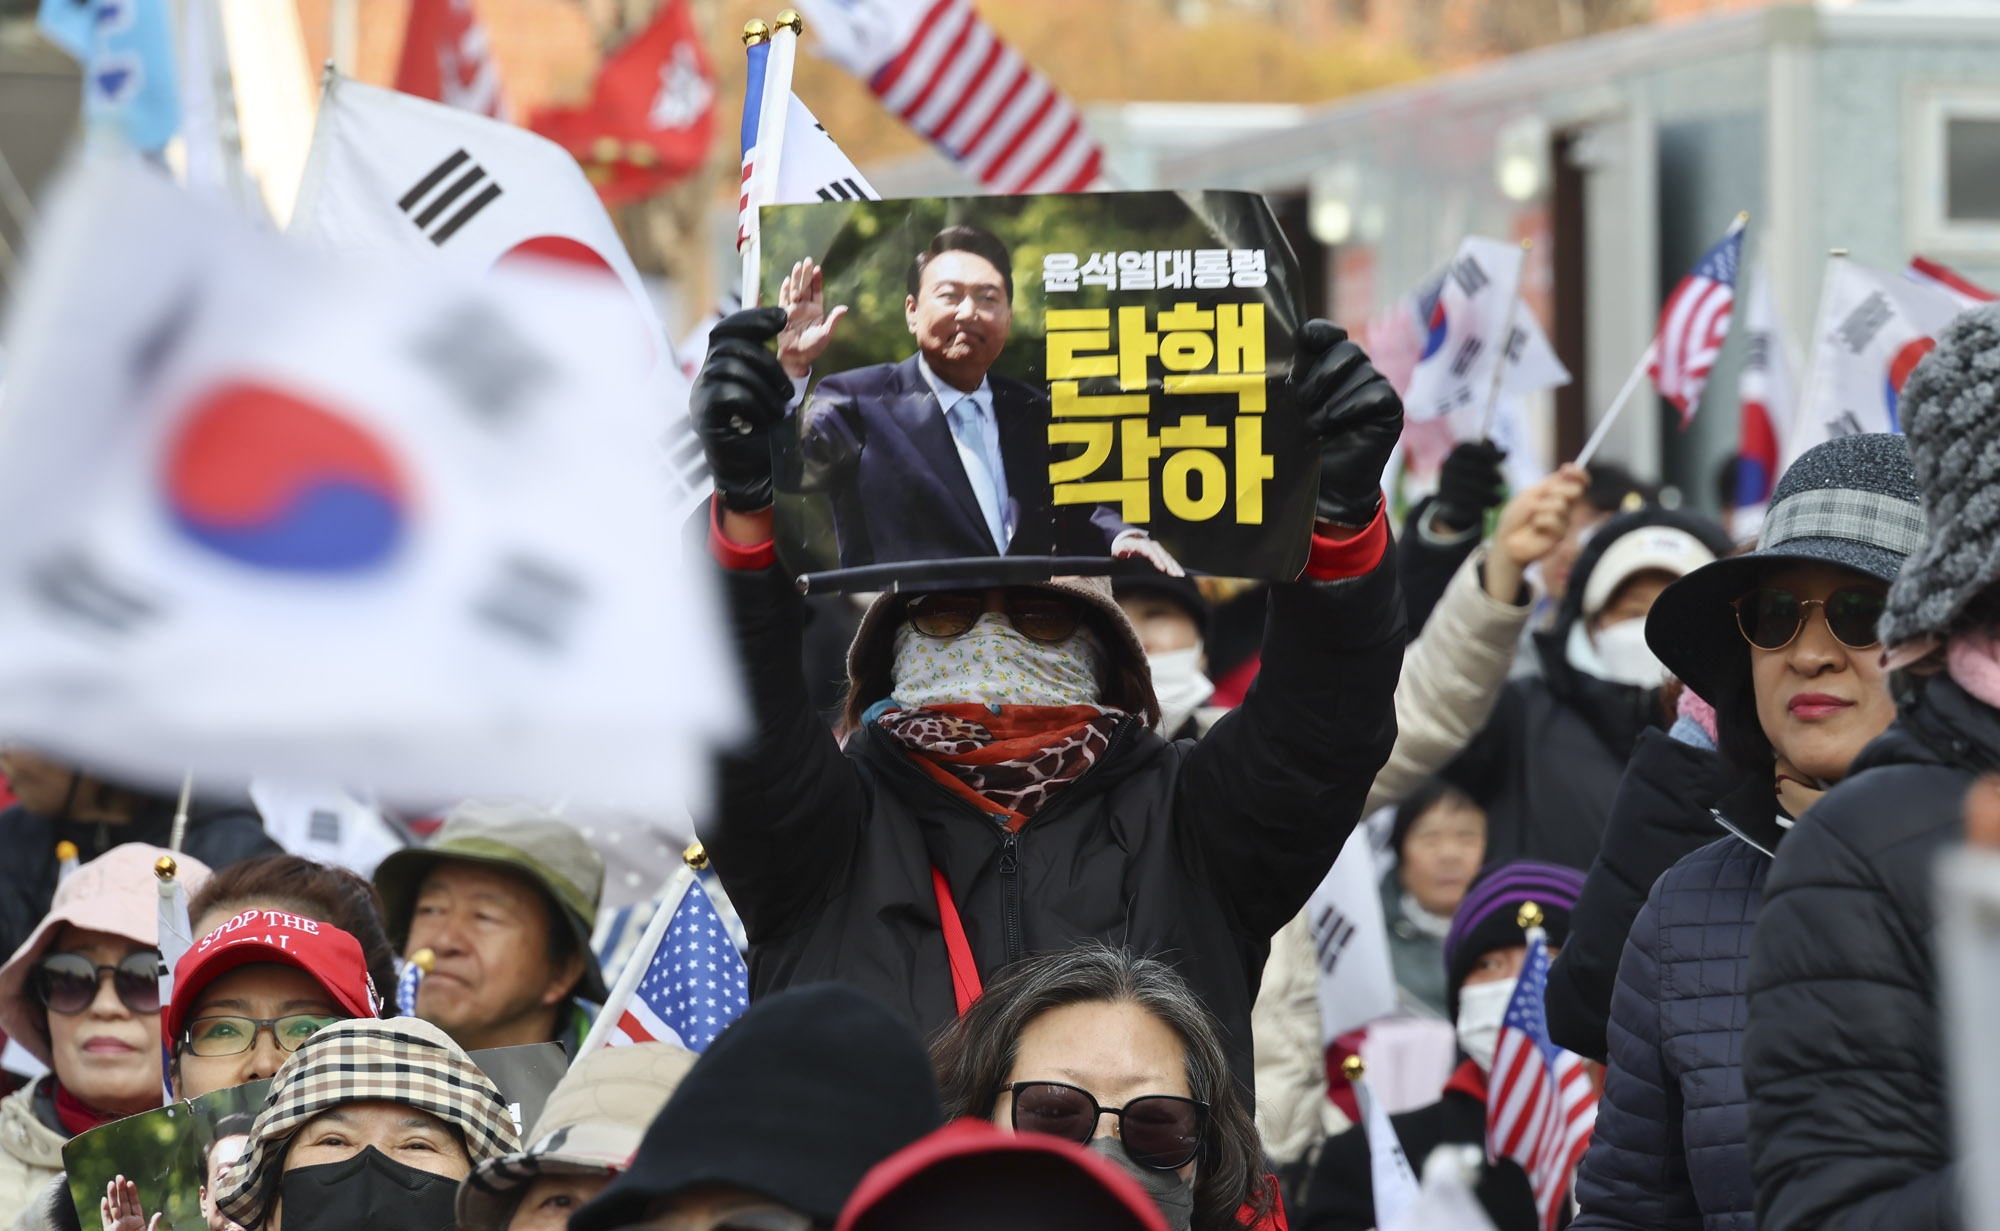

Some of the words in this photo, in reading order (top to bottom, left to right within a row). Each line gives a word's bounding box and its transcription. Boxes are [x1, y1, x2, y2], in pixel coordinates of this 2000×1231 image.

[1042, 249, 1268, 292] 윤석열대통령
[1045, 302, 1267, 418] 탄핵
[1047, 415, 1275, 525] 각하
[198, 909, 259, 953] STOP
[262, 911, 320, 936] THE
